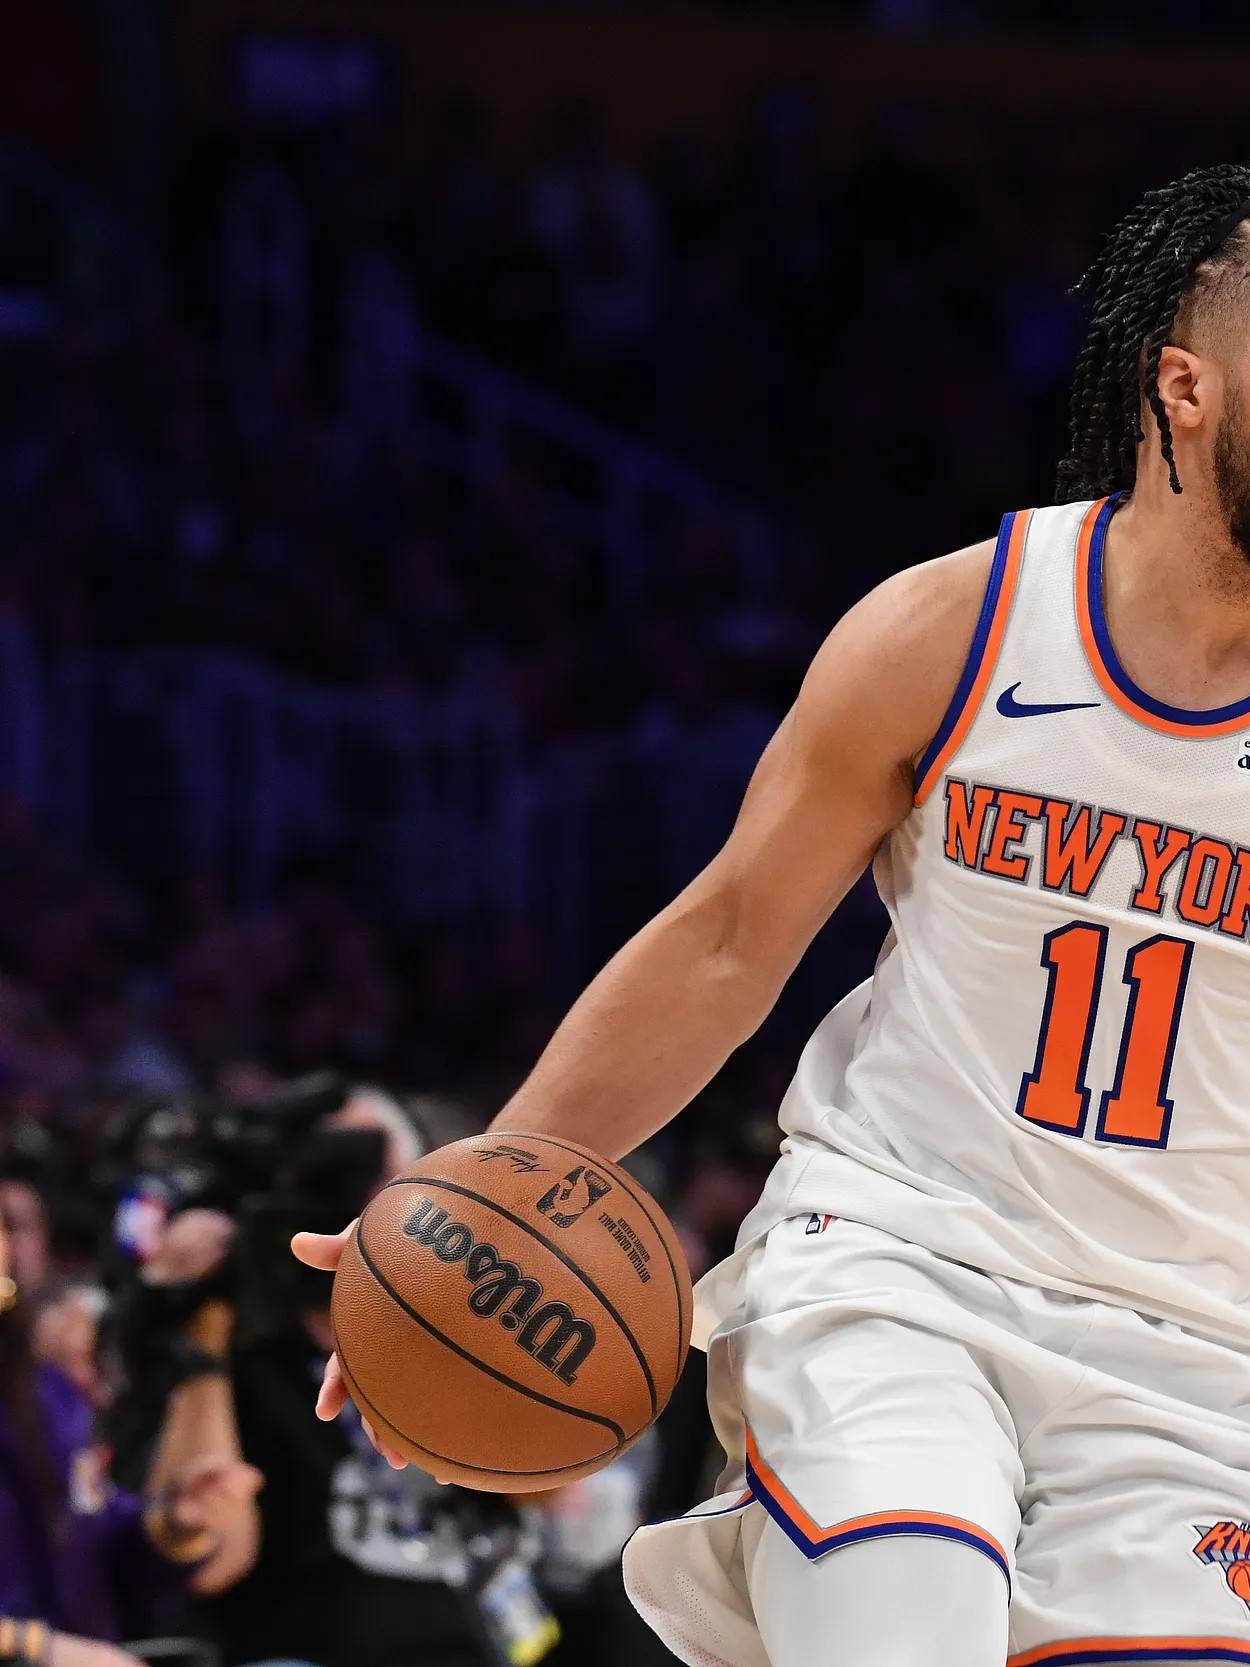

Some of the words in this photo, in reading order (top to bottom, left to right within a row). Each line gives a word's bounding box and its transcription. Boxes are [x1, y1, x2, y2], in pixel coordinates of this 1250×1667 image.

[943, 775, 1129, 901] NEW
[1015, 919, 1195, 1150] 11
[598, 1211, 618, 1233] BALL
[627, 1247, 651, 1284] OFFICIAL
[402, 1198, 597, 1388] Wilson
